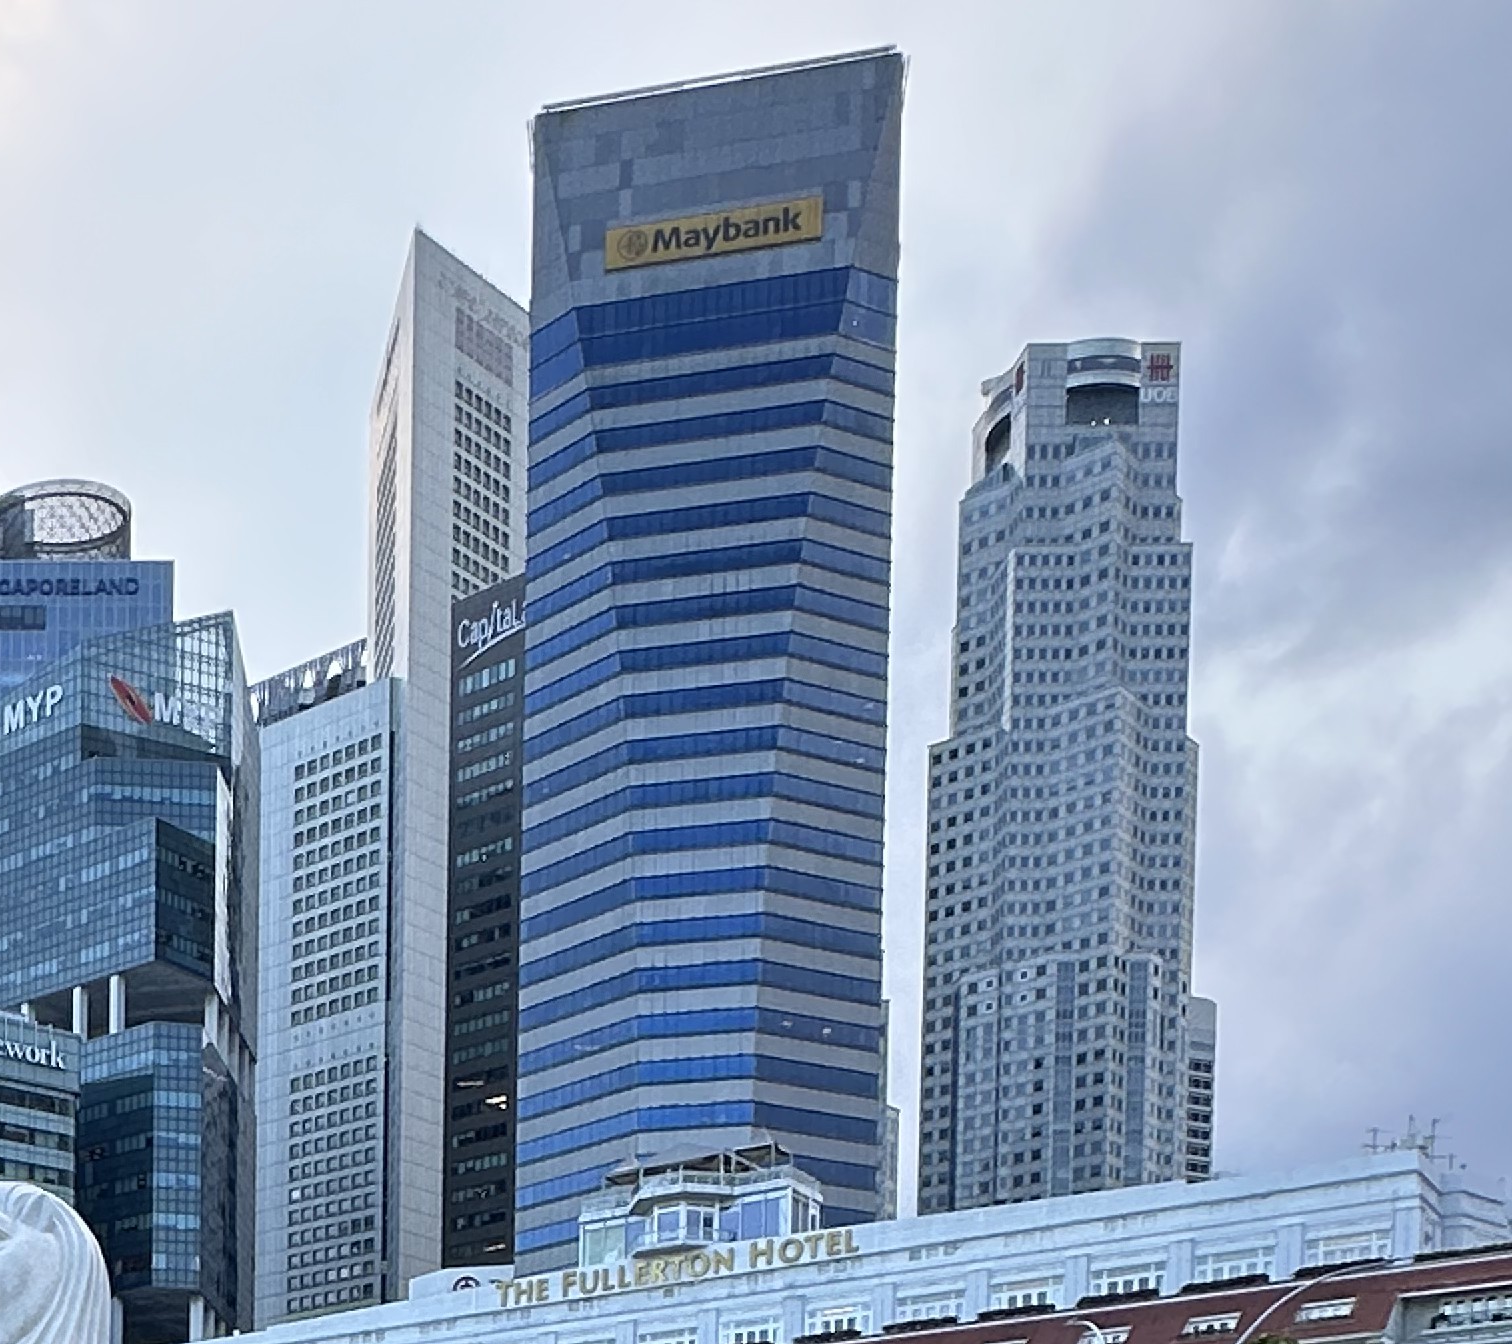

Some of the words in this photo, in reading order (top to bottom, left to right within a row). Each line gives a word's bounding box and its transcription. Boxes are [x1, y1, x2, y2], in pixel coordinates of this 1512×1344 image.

[651, 207, 802, 253] Maybank
[3, 684, 64, 735] MYP
[496, 1277, 550, 1308] THE
[561, 1247, 735, 1299] FULLERTON
[748, 1229, 860, 1269] HOTEL
